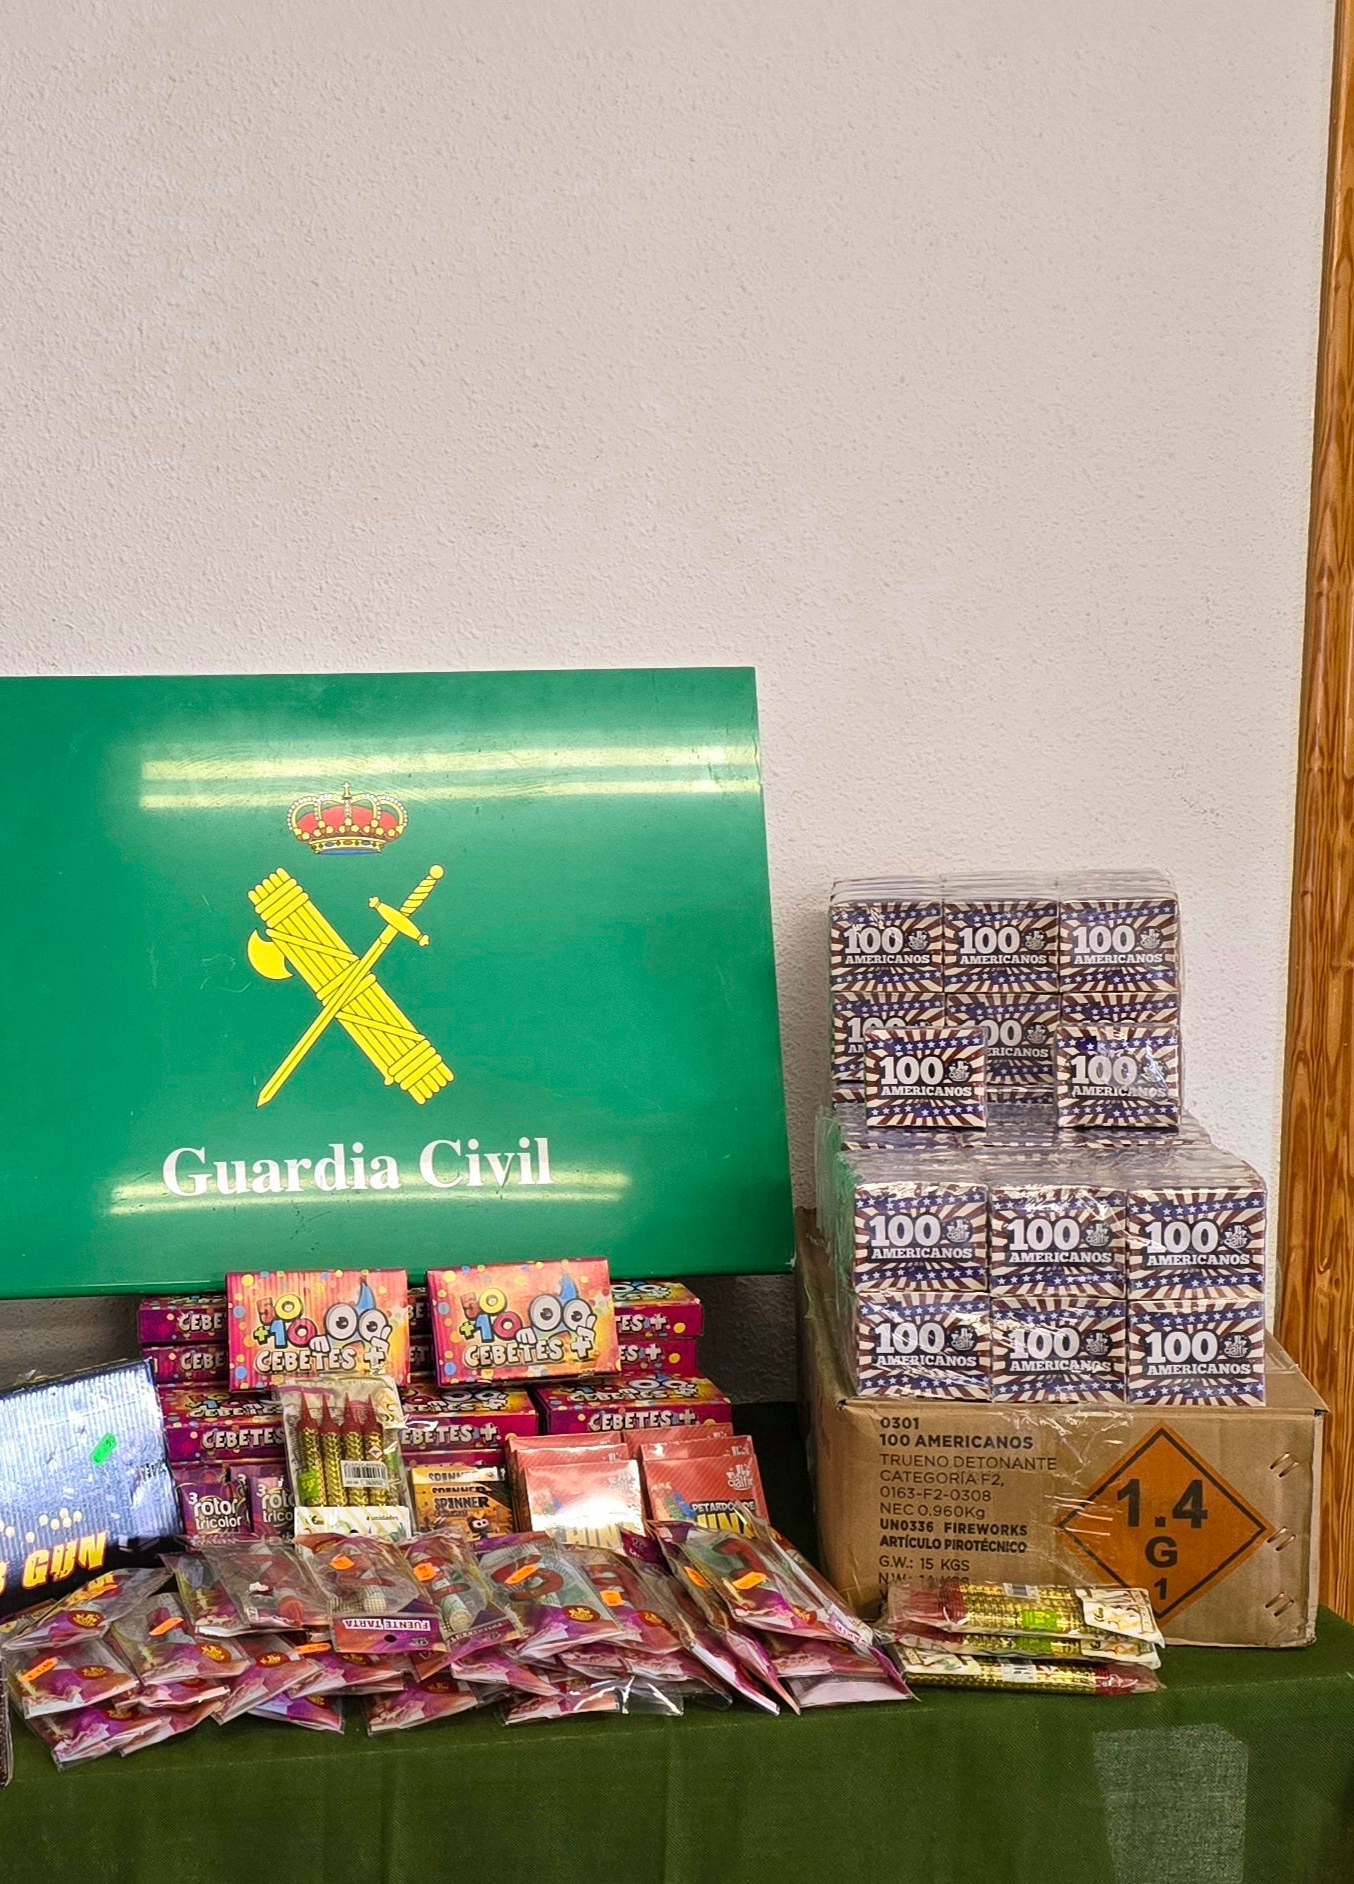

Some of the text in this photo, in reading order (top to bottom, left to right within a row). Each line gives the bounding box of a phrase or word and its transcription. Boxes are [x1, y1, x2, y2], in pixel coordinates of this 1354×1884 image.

[844, 927, 903, 953] 100
[959, 927, 1020, 954] 100
[1073, 925, 1136, 953] 100
[845, 955, 930, 965] AMERICANOS
[960, 955, 1047, 965] AMERICANOS
[1074, 954, 1163, 965] AMERICANOS
[961, 1019, 1022, 1046] 00
[986, 1047, 1049, 1058] ERICANOS
[879, 1056, 944, 1085] 100
[1071, 1055, 1137, 1085] 100
[881, 1086, 972, 1097] AMERICANOS
[1072, 1085, 1168, 1099] AMERICANOS
[162, 1137, 554, 1196] Guardia Civil
[869, 1215, 941, 1247] 100
[1006, 1218, 1080, 1250] 100
[1145, 1221, 1219, 1253] 100
[871, 1248, 973, 1259] AMERICANOS
[1009, 1252, 1112, 1263] AMERICANOS
[1146, 1254, 1250, 1266] AMERICANOS
[256, 1294, 303, 1326] 50
[460, 1287, 507, 1319] 50
[179, 1312, 223, 1331] CEBE
[875, 1322, 944, 1354] 100
[1008, 1327, 1080, 1359] 100
[1145, 1331, 1218, 1363] 100
[255, 1347, 356, 1374] CEBETES
[464, 1336, 564, 1367] CEBETES
[181, 1352, 225, 1370] CEBE
[876, 1356, 977, 1368] AMERICANOS
[1010, 1361, 1112, 1373] AMERICANOS
[1147, 1364, 1252, 1376] AMERICANOS
[588, 1410, 672, 1431] CEBETES
[880, 1417, 919, 1430] 0301
[401, 1424, 472, 1447] EBETES
[879, 1434, 1034, 1450] 100 AMERICANOS
[880, 1454, 1058, 1470] TRUENO DETONANTE
[880, 1470, 1005, 1487] CATEGORÍA F2,
[188, 1492, 198, 1505] 3
[256, 1484, 266, 1497] 3
[262, 1490, 295, 1509] roto
[880, 1486, 992, 1502] 0163-F2-0308
[194, 1498, 237, 1517] rotor
[434, 1497, 490, 1509] SPINNER
[692, 1501, 735, 1513] PETARDO
[880, 1503, 986, 1520] NEC 0.960Kg
[1117, 1478, 1208, 1529] 1.4
[195, 1516, 241, 1530] tricolor
[263, 1510, 293, 1523] trico
[880, 1519, 1028, 1536] UN0336 FIREWORKS
[880, 1534, 1027, 1553] ARTÍCULO PIROTÉCNICO
[1145, 1536, 1178, 1568] G
[22, 1530, 110, 1590] GUN
[879, 1555, 970, 1572] G.W.: 15 KGS
[1154, 1578, 1167, 1600] 1
[344, 1619, 430, 1631] FUENTE TARTA
